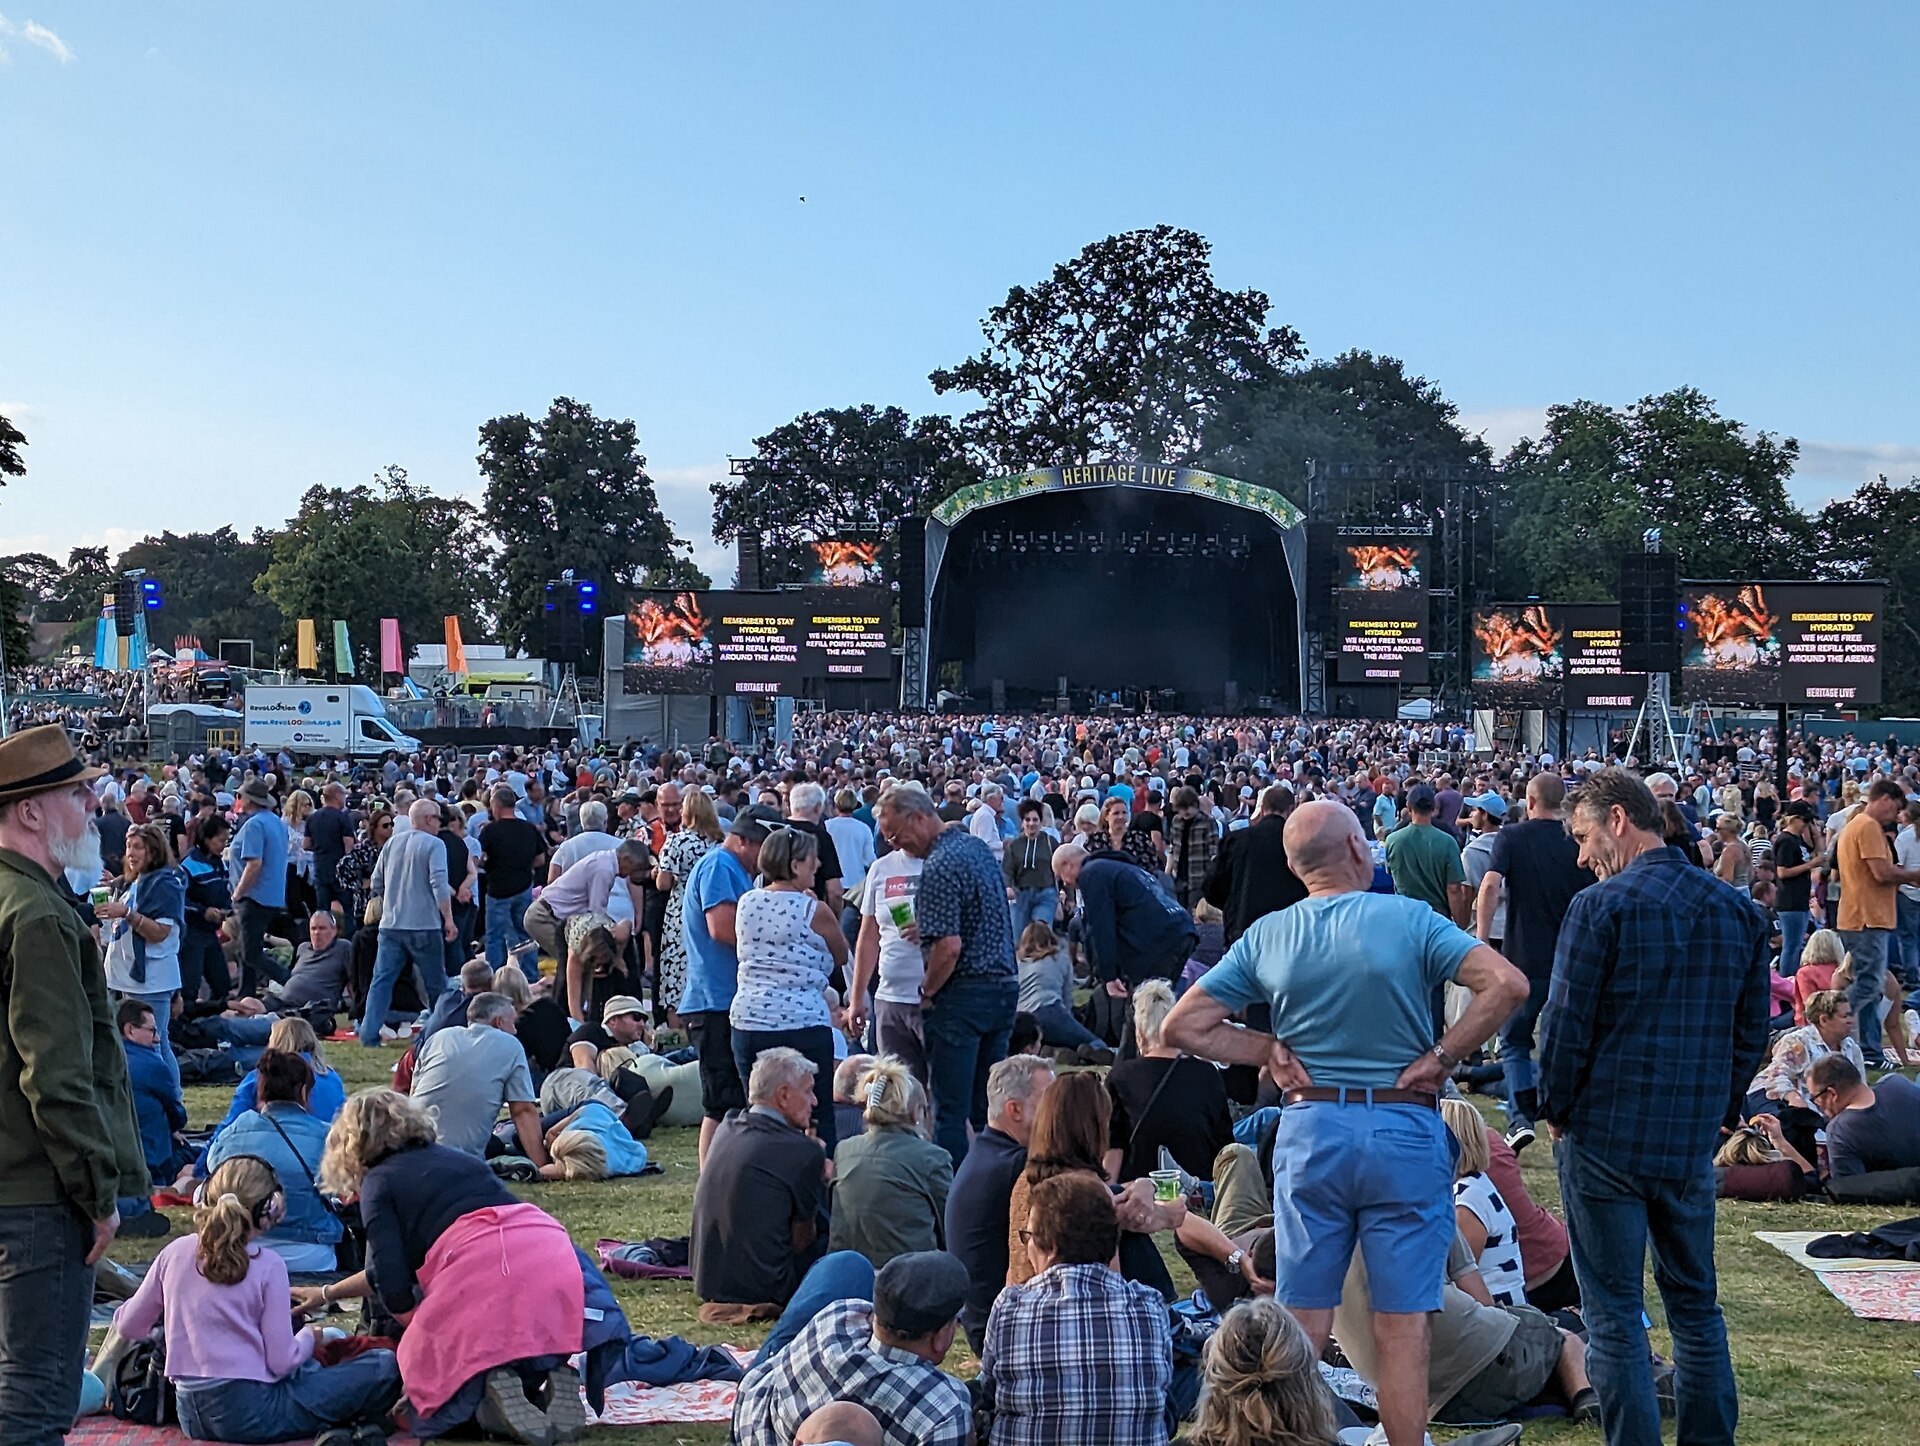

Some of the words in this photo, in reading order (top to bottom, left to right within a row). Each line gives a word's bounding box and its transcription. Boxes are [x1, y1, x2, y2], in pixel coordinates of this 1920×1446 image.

[1062, 465, 1136, 486] HERITAGE
[1141, 466, 1176, 487] LIVE
[736, 682, 764, 691] HERITAGE
[765, 682, 778, 692] LIVE
[1806, 688, 1839, 697] HERITAGE
[1839, 688, 1855, 698] LIVE
[1587, 696, 1617, 705] HERITAGE
[1618, 696, 1632, 706] LIVE
